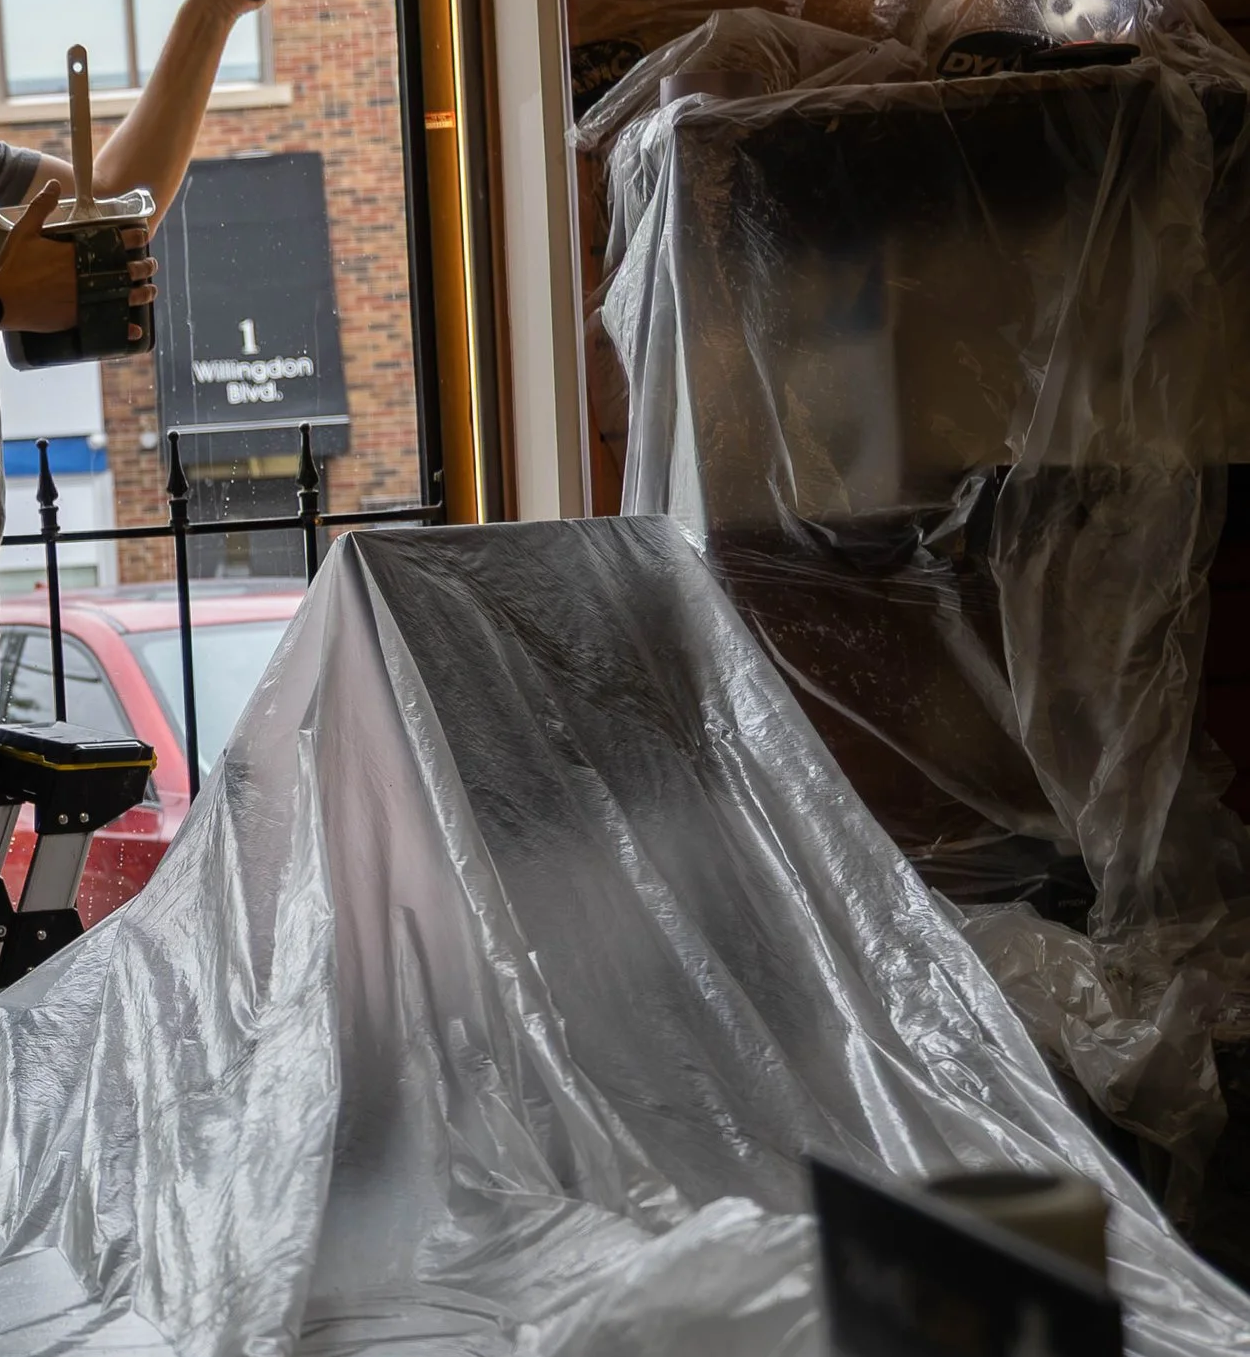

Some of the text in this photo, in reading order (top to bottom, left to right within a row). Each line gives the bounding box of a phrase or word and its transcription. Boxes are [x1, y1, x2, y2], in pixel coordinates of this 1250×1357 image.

[238, 319, 259, 354] 1
[193, 356, 314, 384] Willingdon
[227, 381, 283, 404] Blvd.
